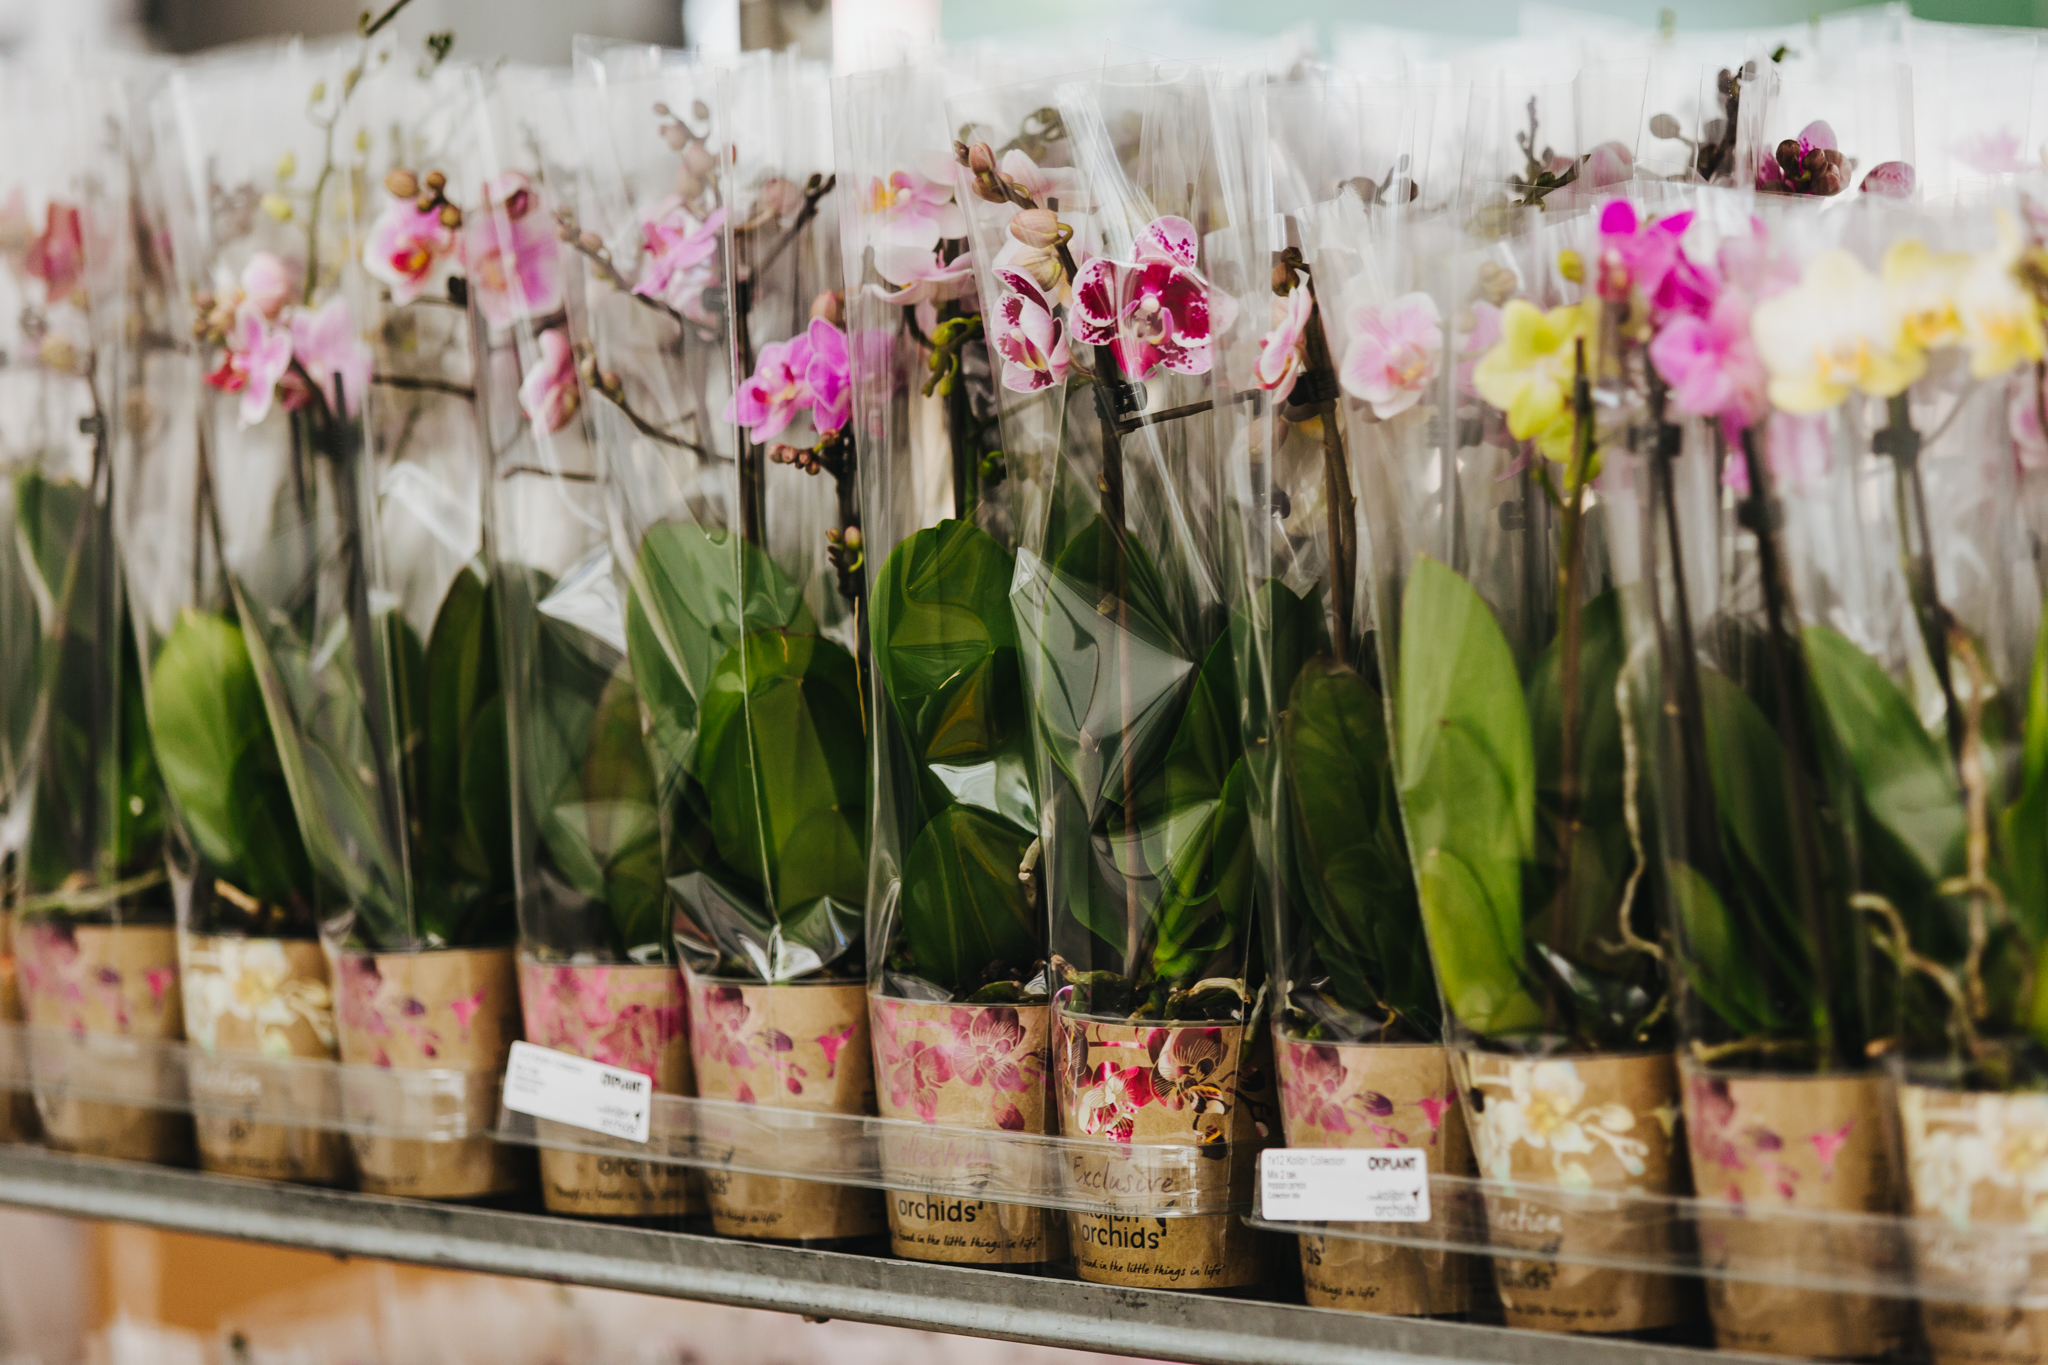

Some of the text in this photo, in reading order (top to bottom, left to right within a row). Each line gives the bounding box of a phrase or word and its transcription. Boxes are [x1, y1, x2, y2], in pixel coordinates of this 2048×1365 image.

[1073, 1156, 1175, 1194] Exclusive
[943, 1235, 967, 1247] little
[1082, 1220, 1160, 1249] orchids
[1110, 1260, 1123, 1272] the
[1126, 1262, 1150, 1275] little
[1154, 1264, 1186, 1281] things
[1190, 1266, 1200, 1276] in
